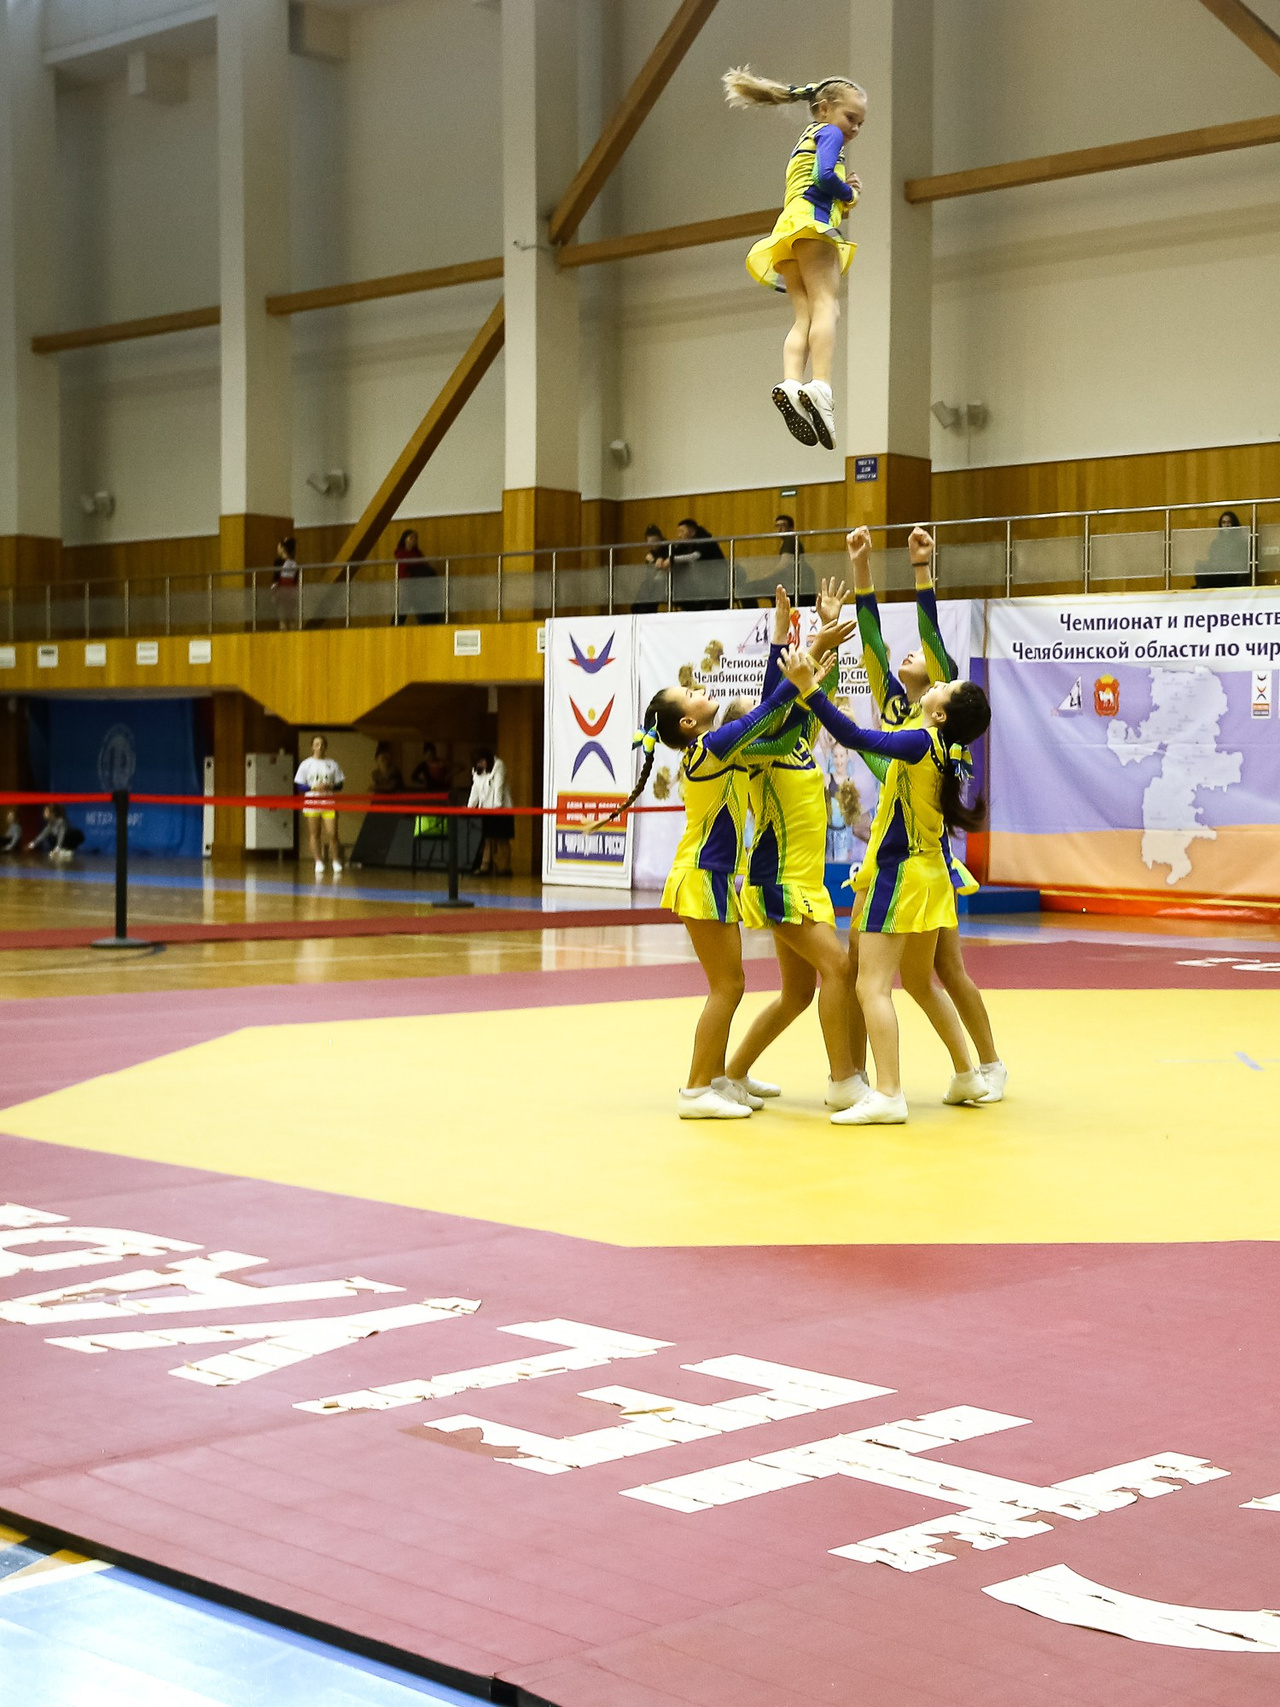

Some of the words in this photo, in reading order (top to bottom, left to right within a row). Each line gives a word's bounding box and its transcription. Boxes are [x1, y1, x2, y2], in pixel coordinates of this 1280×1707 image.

[1060, 612, 1163, 632] Чемпионат
[1167, 615, 1179, 629] и
[1012, 640, 1129, 661] Челябинской
[1134, 639, 1210, 659] области
[1215, 643, 1240, 658] по
[1246, 642, 1280, 662] чир
[694, 671, 764, 683] Челябинской
[709, 688, 727, 698] для
[728, 687, 763, 697] начин
